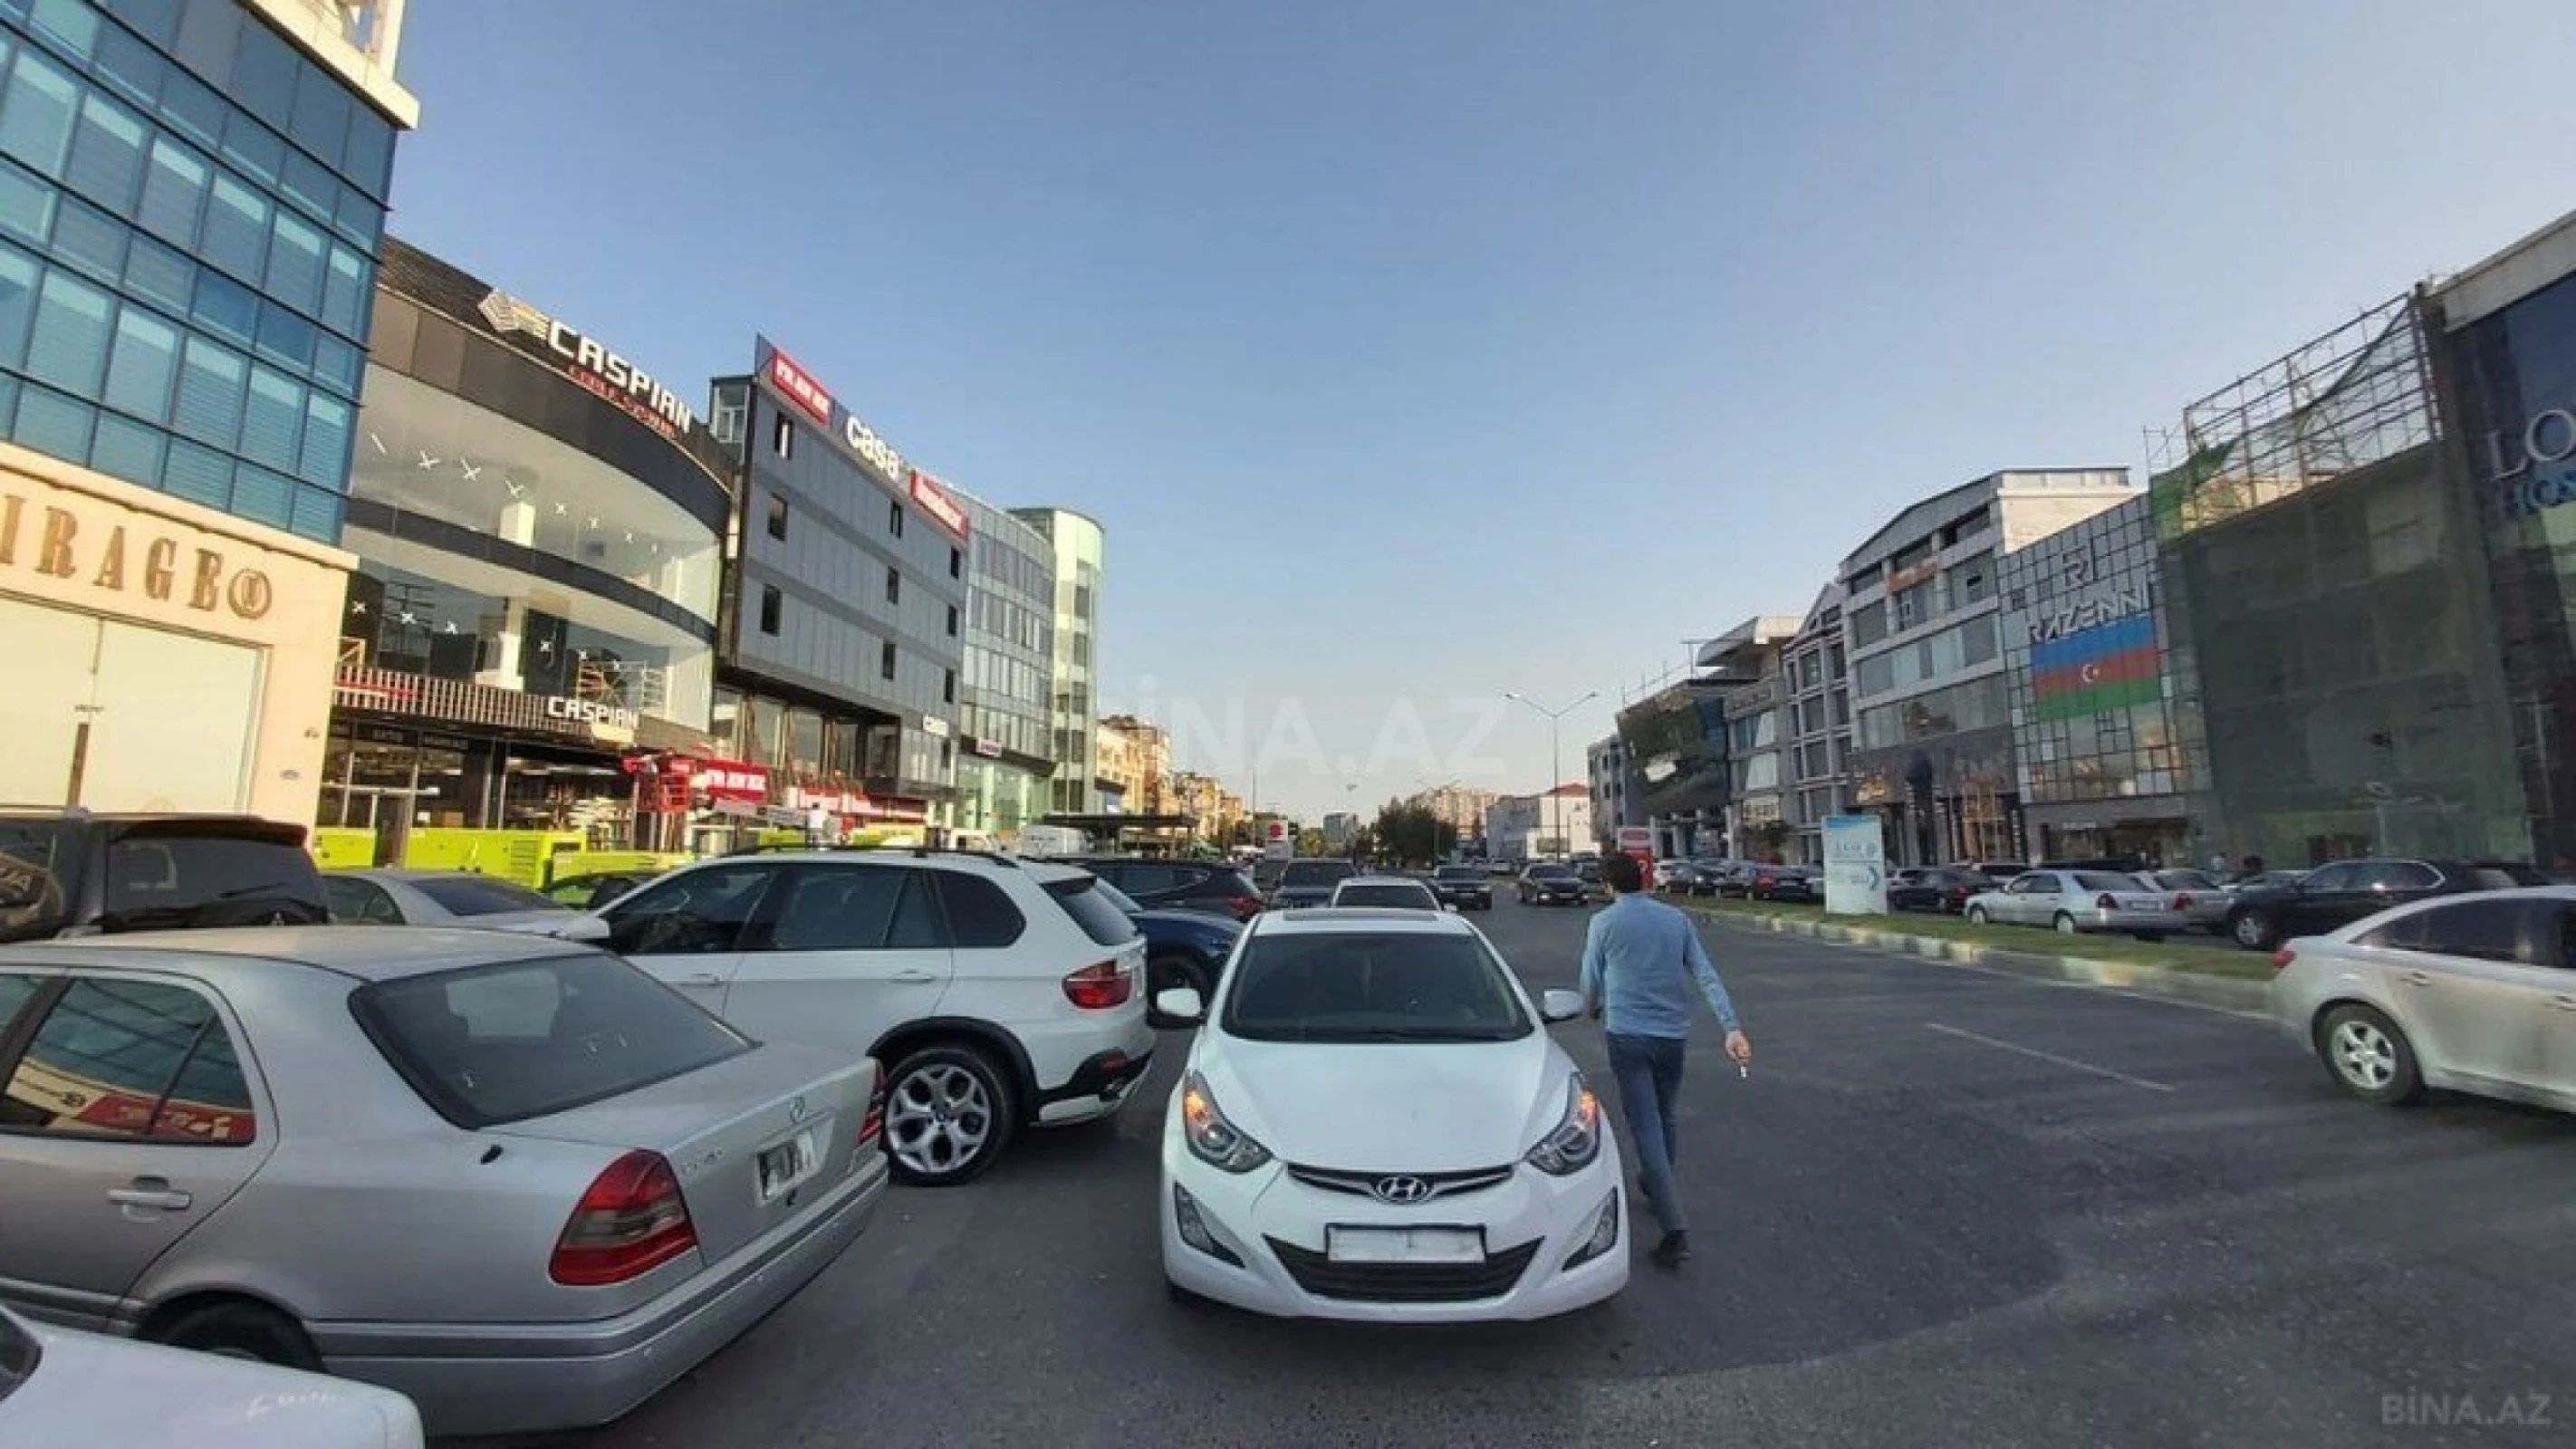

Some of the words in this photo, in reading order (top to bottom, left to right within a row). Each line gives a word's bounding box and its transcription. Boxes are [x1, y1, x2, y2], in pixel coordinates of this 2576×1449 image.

[549, 319, 691, 434] CASPIAN
[847, 415, 899, 482] casa
[548, 696, 639, 731] CASPIAN
